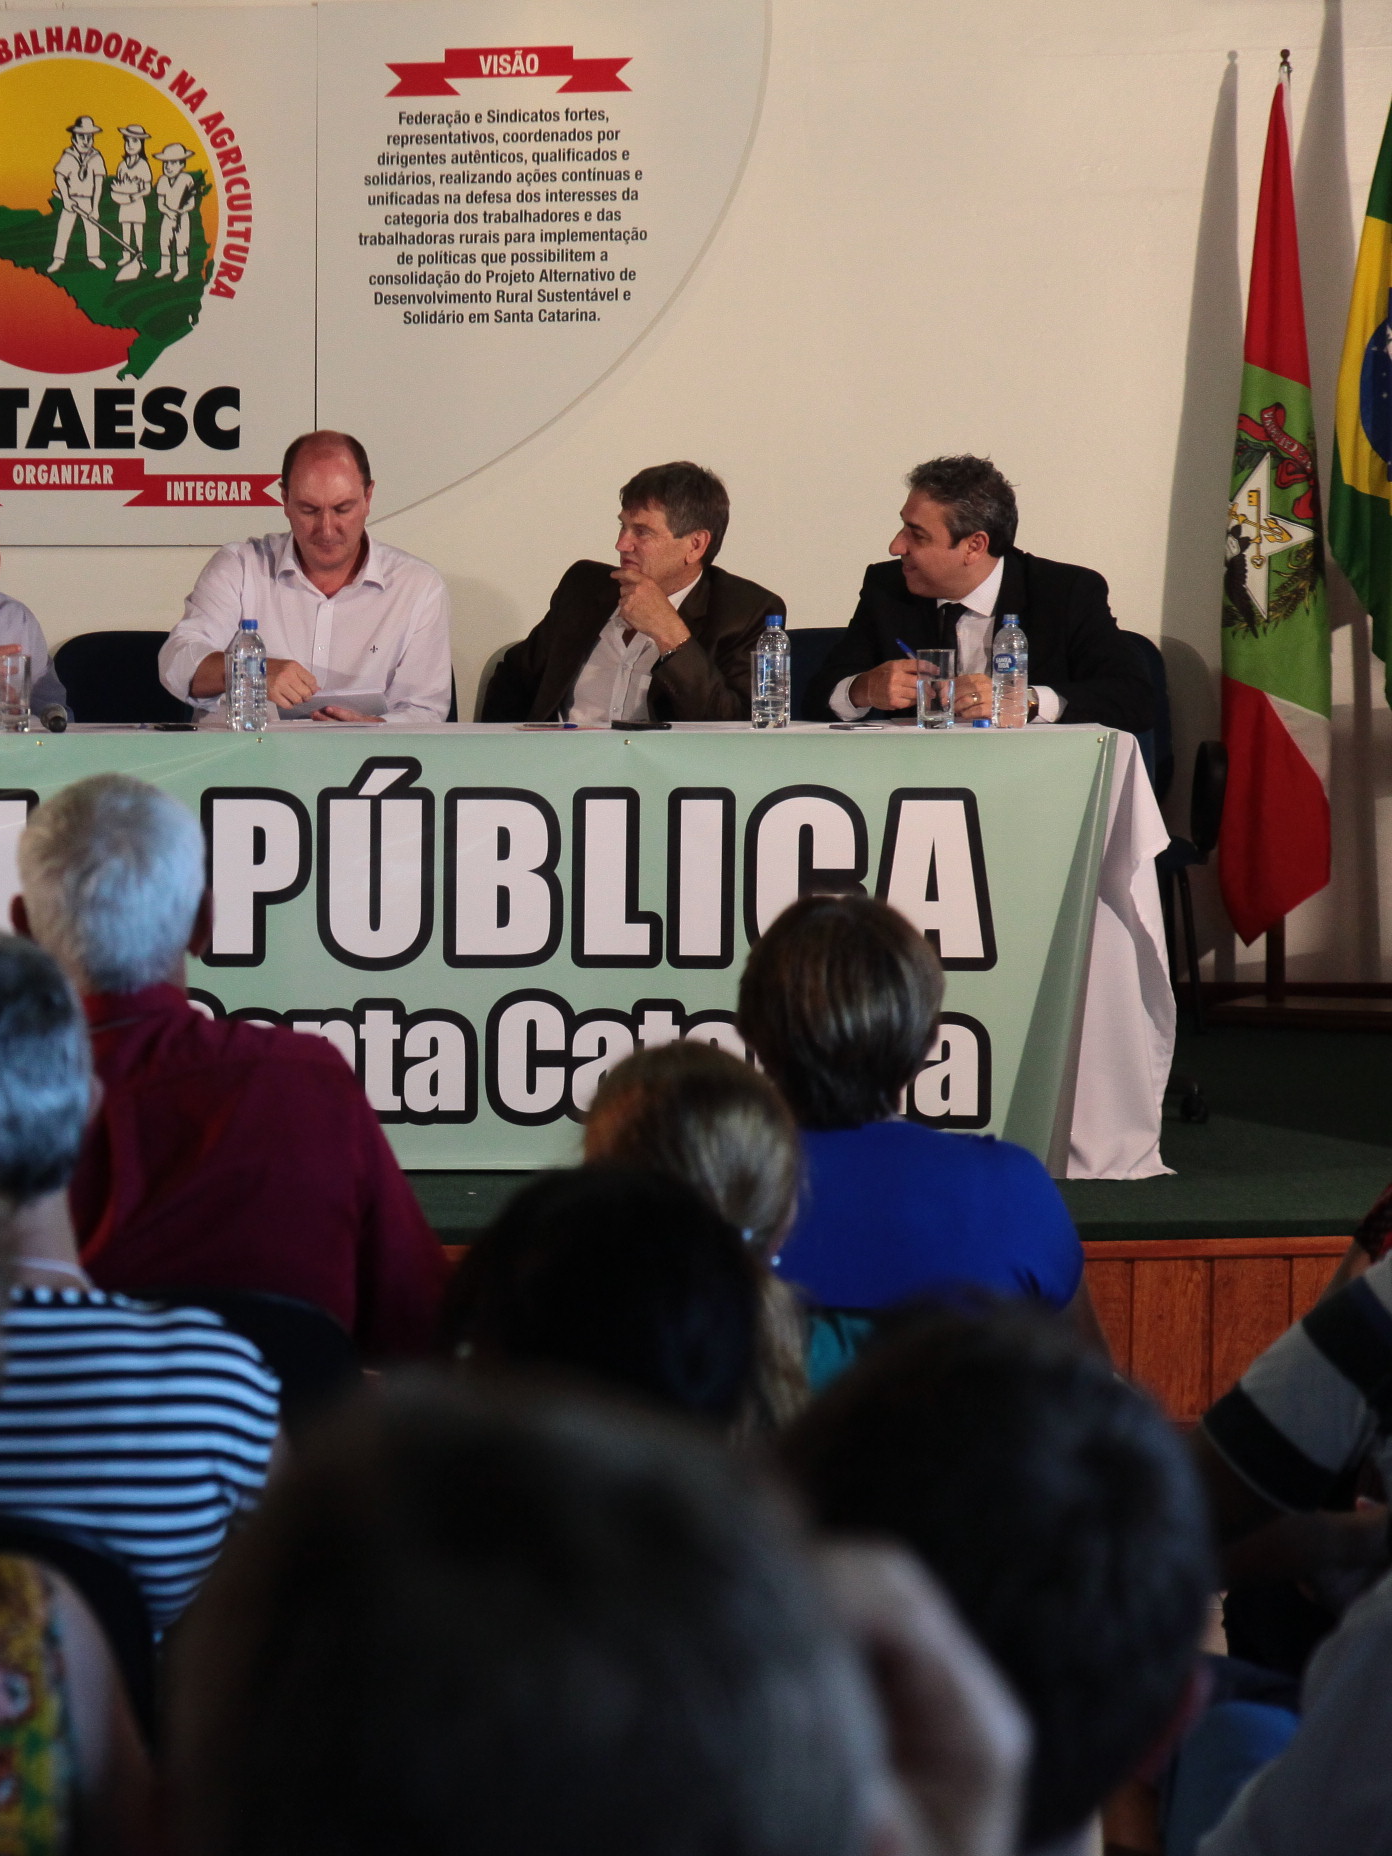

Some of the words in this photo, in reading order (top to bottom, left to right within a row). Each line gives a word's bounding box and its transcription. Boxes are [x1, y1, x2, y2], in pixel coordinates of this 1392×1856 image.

[479, 50, 539, 75] VISÃO
[398, 110, 471, 128] Federação
[474, 112, 483, 124] e
[486, 108, 561, 124] Sindicatos
[564, 107, 610, 124] fortes,
[386, 130, 499, 149] representativos,
[502, 127, 593, 144] coordenados
[597, 129, 621, 145] por
[377, 151, 447, 169] dirigentes
[450, 149, 528, 166] autênticos,
[531, 147, 618, 167] qualificados
[621, 149, 630, 161] e
[169, 70, 208, 112] NA
[198, 110, 253, 300] AGRICULTURA
[364, 171, 436, 187] solidários,
[439, 169, 513, 185] realizando
[516, 169, 558, 187] ações
[561, 167, 631, 183] contínuas
[634, 169, 643, 181] e
[367, 190, 440, 206] unificadas
[444, 193, 461, 205] na
[465, 189, 512, 205] defesa
[515, 189, 541, 204] dos
[545, 188, 618, 203] interesses
[621, 186, 639, 201] da
[384, 210, 450, 228] categoria
[453, 210, 479, 225] dos
[482, 208, 580, 224] trabalhadores
[583, 211, 593, 223] e
[596, 208, 622, 223] das
[358, 230, 455, 246] trabalhadoras
[459, 229, 500, 245] rurais
[504, 232, 536, 247] para
[539, 226, 648, 246] implementação
[396, 250, 414, 266] de
[417, 250, 477, 268] políticas
[480, 252, 507, 267] que
[510, 248, 596, 267] possibilitem
[599, 250, 609, 263] a
[368, 270, 461, 288] consolidação
[464, 270, 482, 285] do
[485, 269, 535, 287] Projeto
[538, 268, 616, 283] Alternativo
[619, 267, 637, 281] de
[373, 289, 492, 306] Desenvolvimento
[496, 289, 533, 304] Rural
[537, 287, 619, 303] Sustentável
[622, 289, 632, 301] e
[403, 310, 465, 325] Solidário
[468, 312, 490, 325] em
[493, 309, 534, 324] Santa
[537, 307, 601, 323] Catarina.
[12, 464, 114, 485] ORGANIZAR
[166, 481, 252, 501] INTEGRAR
[201, 755, 998, 970] PÚBLICA
